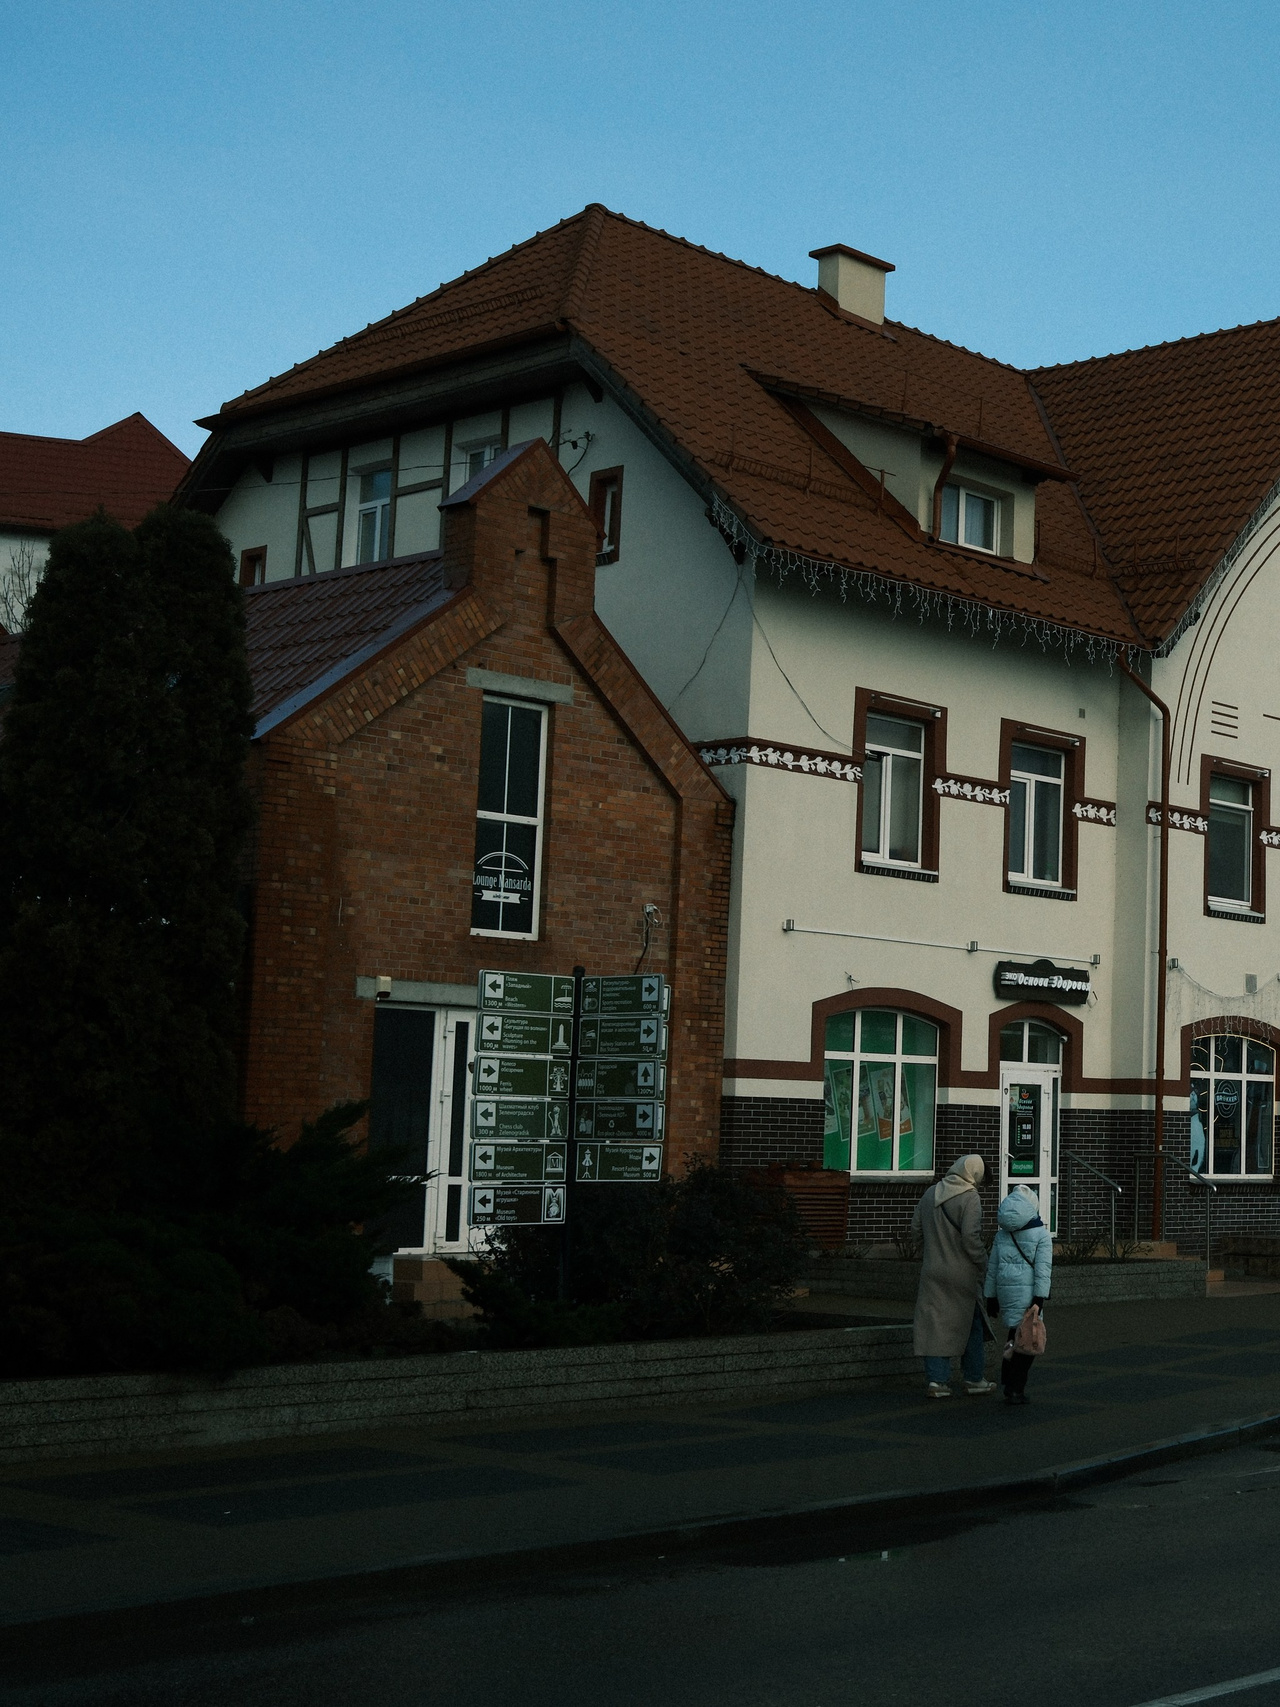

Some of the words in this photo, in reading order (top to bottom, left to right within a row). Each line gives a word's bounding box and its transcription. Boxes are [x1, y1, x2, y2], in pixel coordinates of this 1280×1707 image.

[473, 871, 497, 889] Lounge
[499, 874, 531, 890] Mansarda
[1018, 973, 1049, 988] Основа
[1050, 976, 1092, 992] Здоровья
